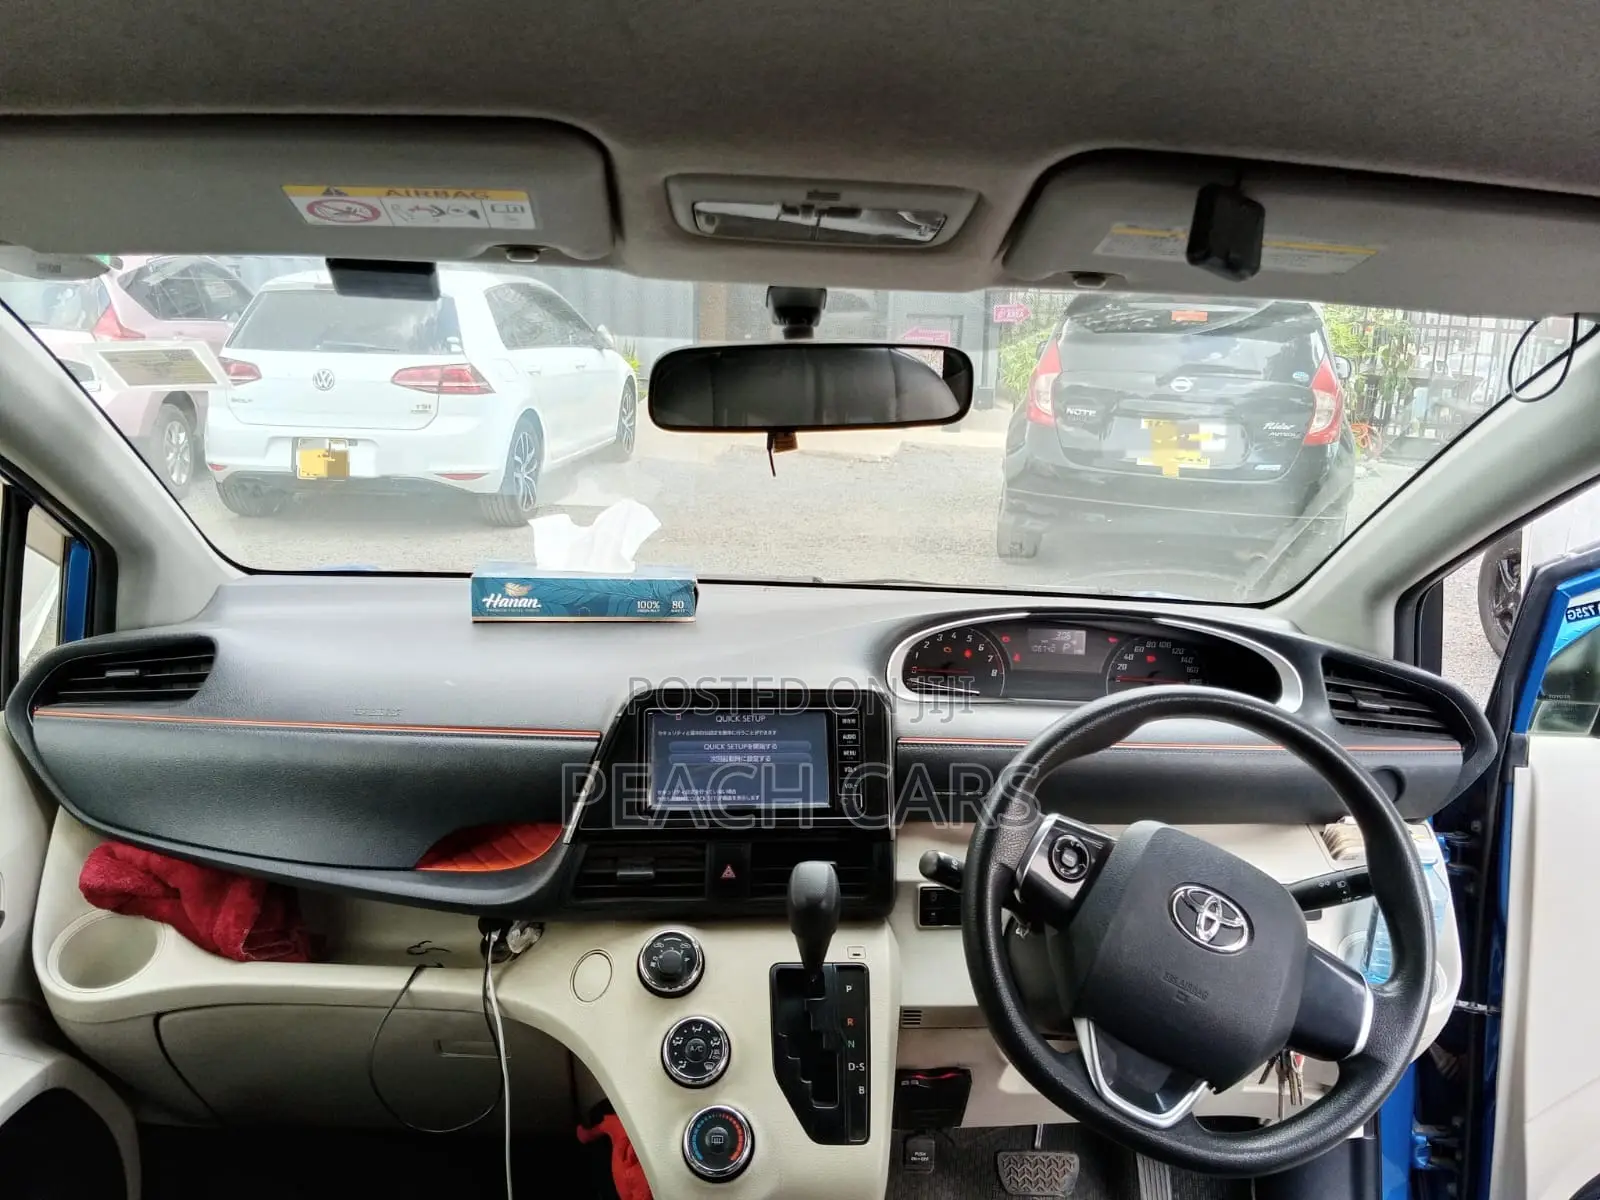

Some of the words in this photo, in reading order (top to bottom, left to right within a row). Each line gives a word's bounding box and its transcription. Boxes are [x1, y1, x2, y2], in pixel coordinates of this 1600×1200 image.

[386, 189, 489, 200] AIRBAG
[482, 593, 542, 609] Hanan
[637, 600, 660, 609] 100%
[672, 600, 685, 609] 80
[1124, 653, 1134, 661] 40
[1117, 663, 1128, 671] 20
[715, 715, 740, 723] QUICK
[742, 715, 766, 723] SETUP
[847, 1018, 854, 1026] R
[848, 1040, 855, 1048] N
[859, 1086, 865, 1094] B
